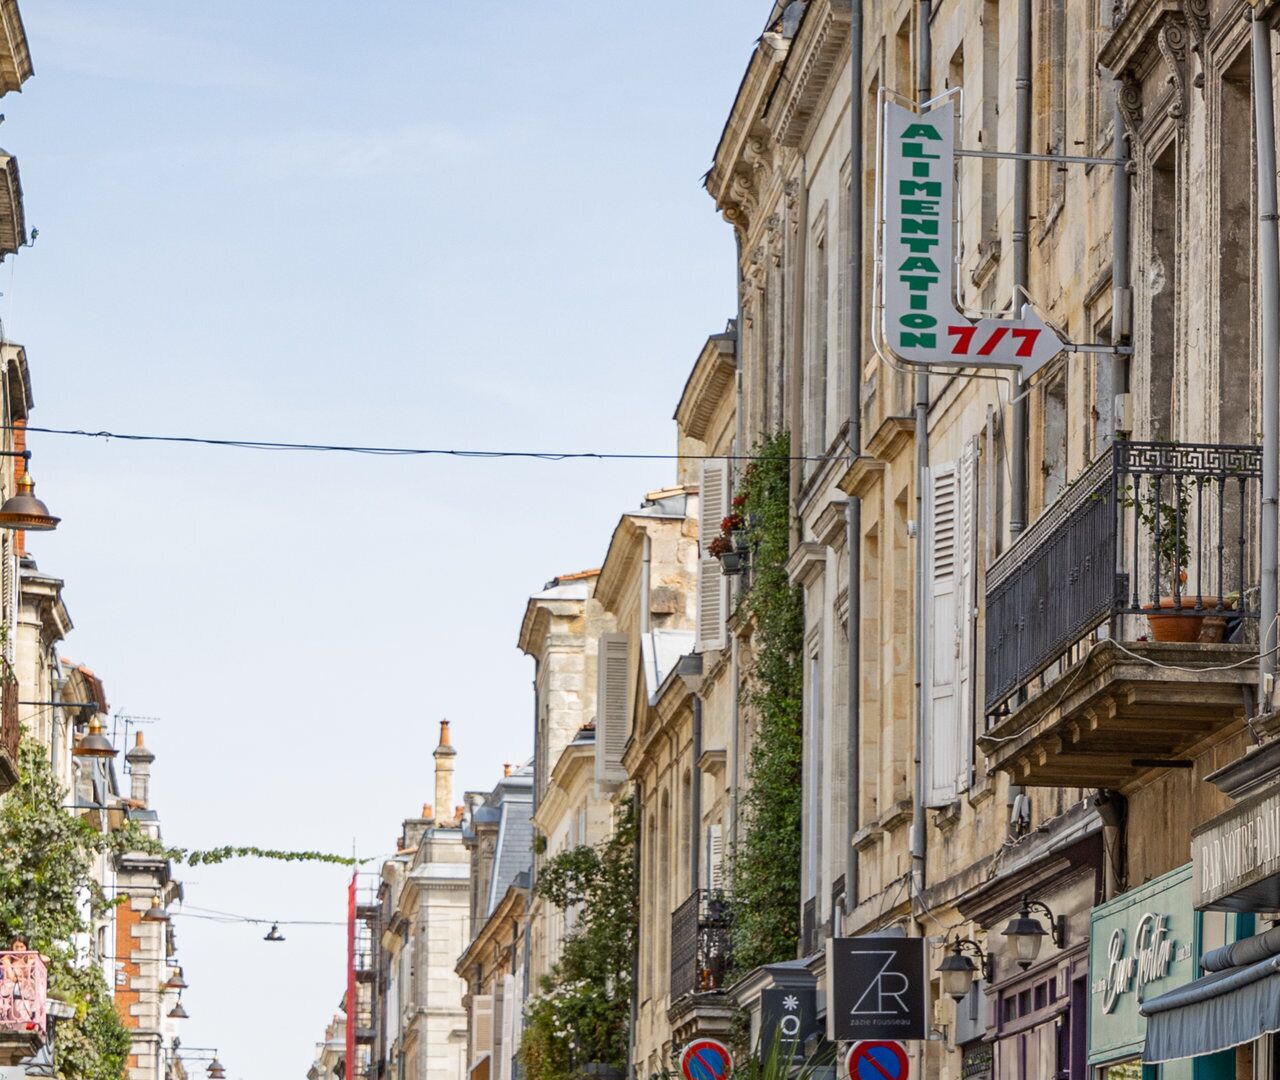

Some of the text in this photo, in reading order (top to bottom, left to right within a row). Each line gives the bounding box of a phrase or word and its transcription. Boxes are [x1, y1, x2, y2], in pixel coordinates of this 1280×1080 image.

[897, 123, 943, 349] ALIMENTATION
[947, 325, 1041, 358] 7/7
[1202, 840, 1221, 893] BAR
